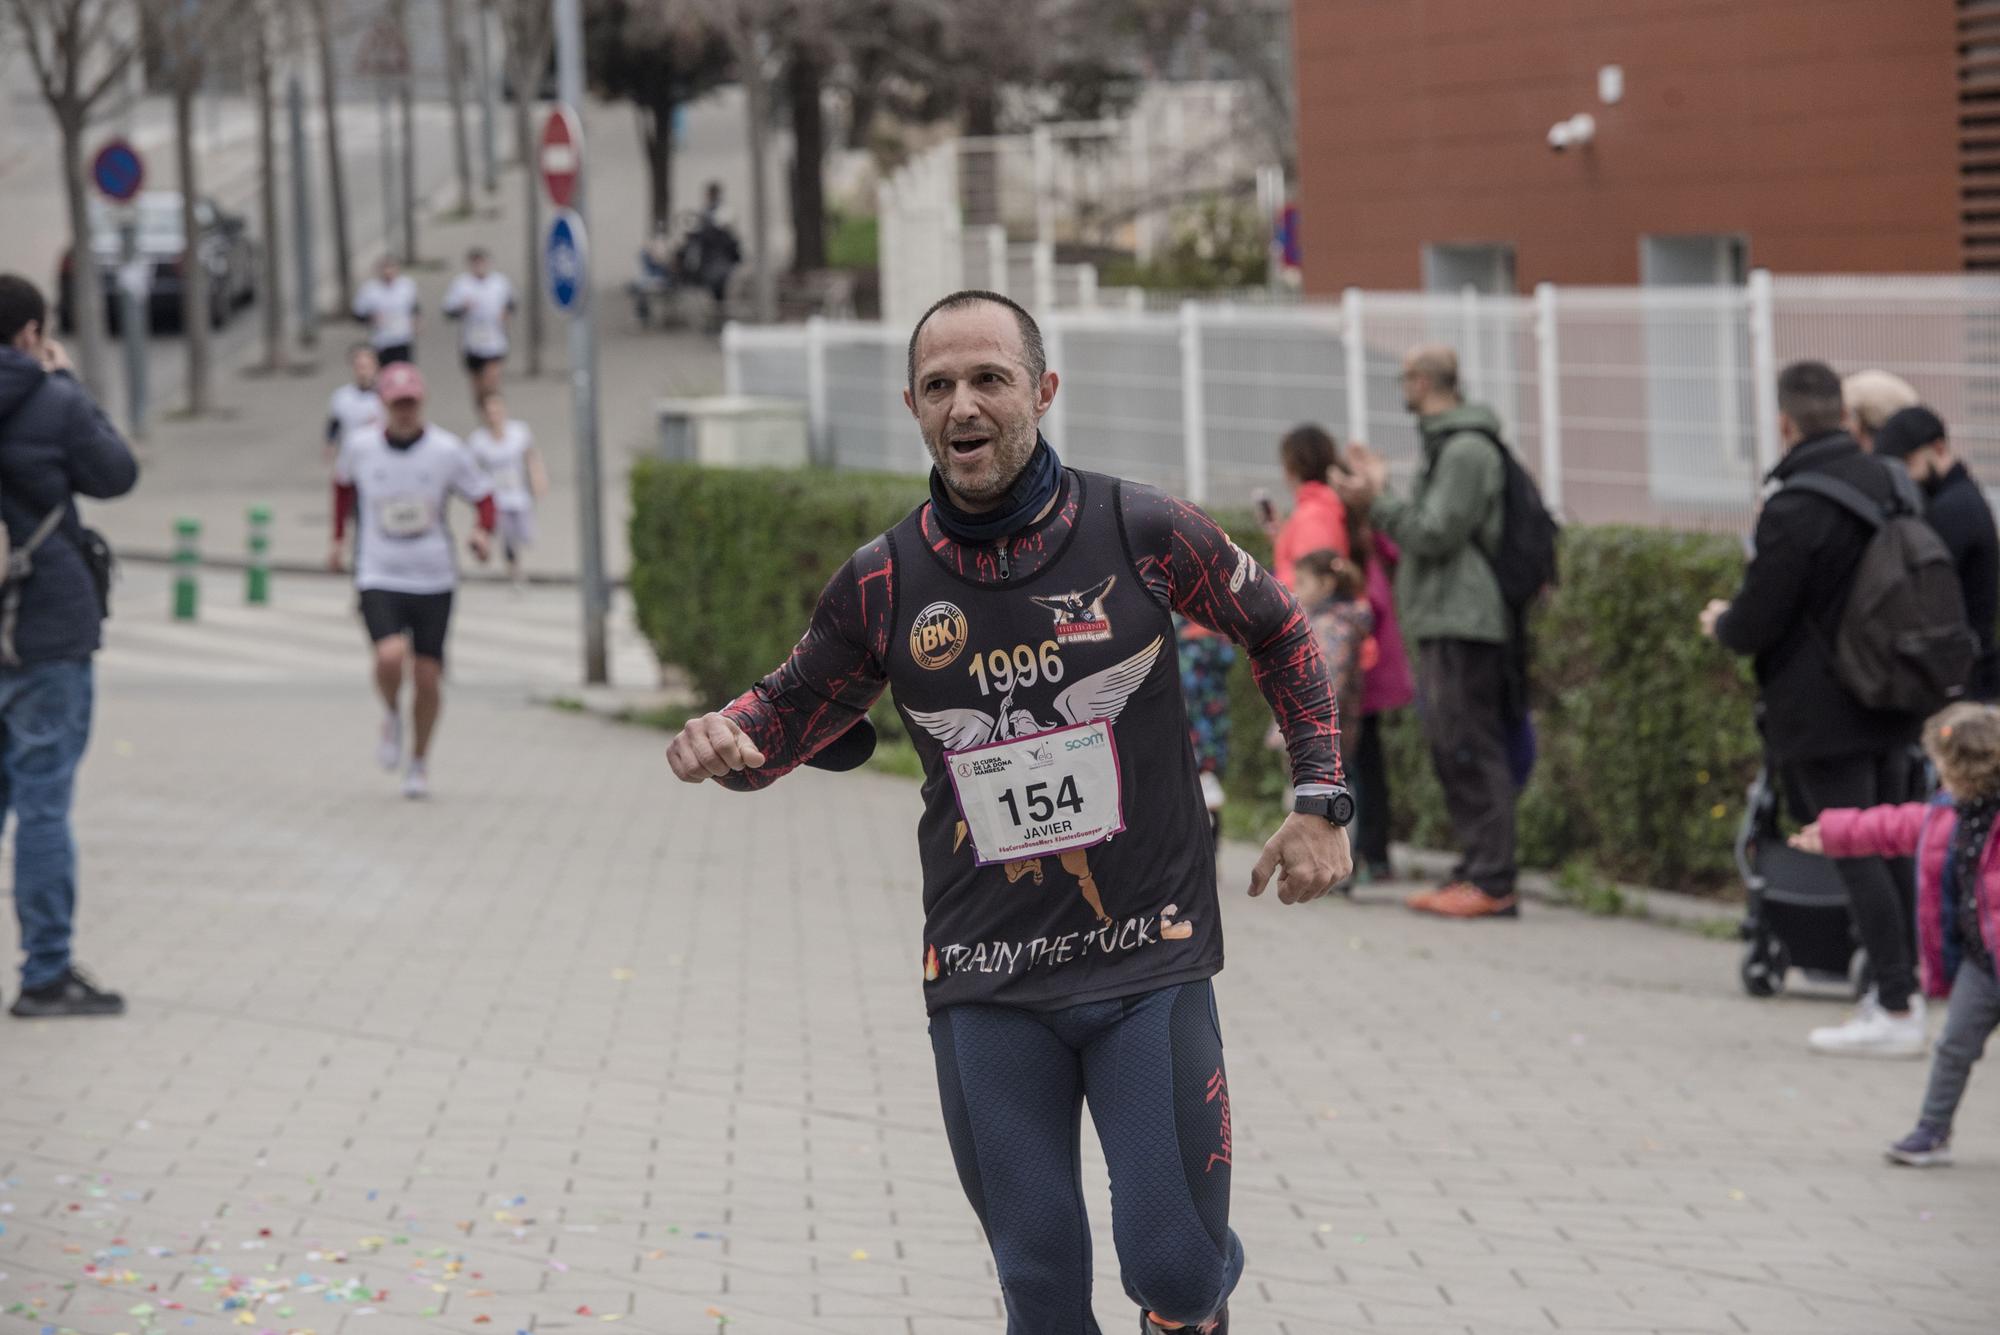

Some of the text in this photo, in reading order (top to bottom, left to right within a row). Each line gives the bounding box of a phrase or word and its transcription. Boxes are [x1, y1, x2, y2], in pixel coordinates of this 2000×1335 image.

[943, 605, 960, 621] FREE
[913, 612, 929, 638] SHARE
[1059, 624, 1074, 634] THE
[922, 618, 956, 652] BK
[1057, 635, 1066, 644] OF
[948, 638, 963, 658] LOVE
[918, 651, 933, 666] FEEL
[969, 640, 1064, 696] 1996
[980, 756, 1002, 765] CURSA
[993, 759, 1013, 768] DONA
[974, 766, 1006, 775] MANRESA
[998, 775, 1084, 826] 154
[1024, 820, 1072, 840] JAVIER
[941, 941, 1022, 976] TRAIN
[1026, 932, 1079, 970] THE
